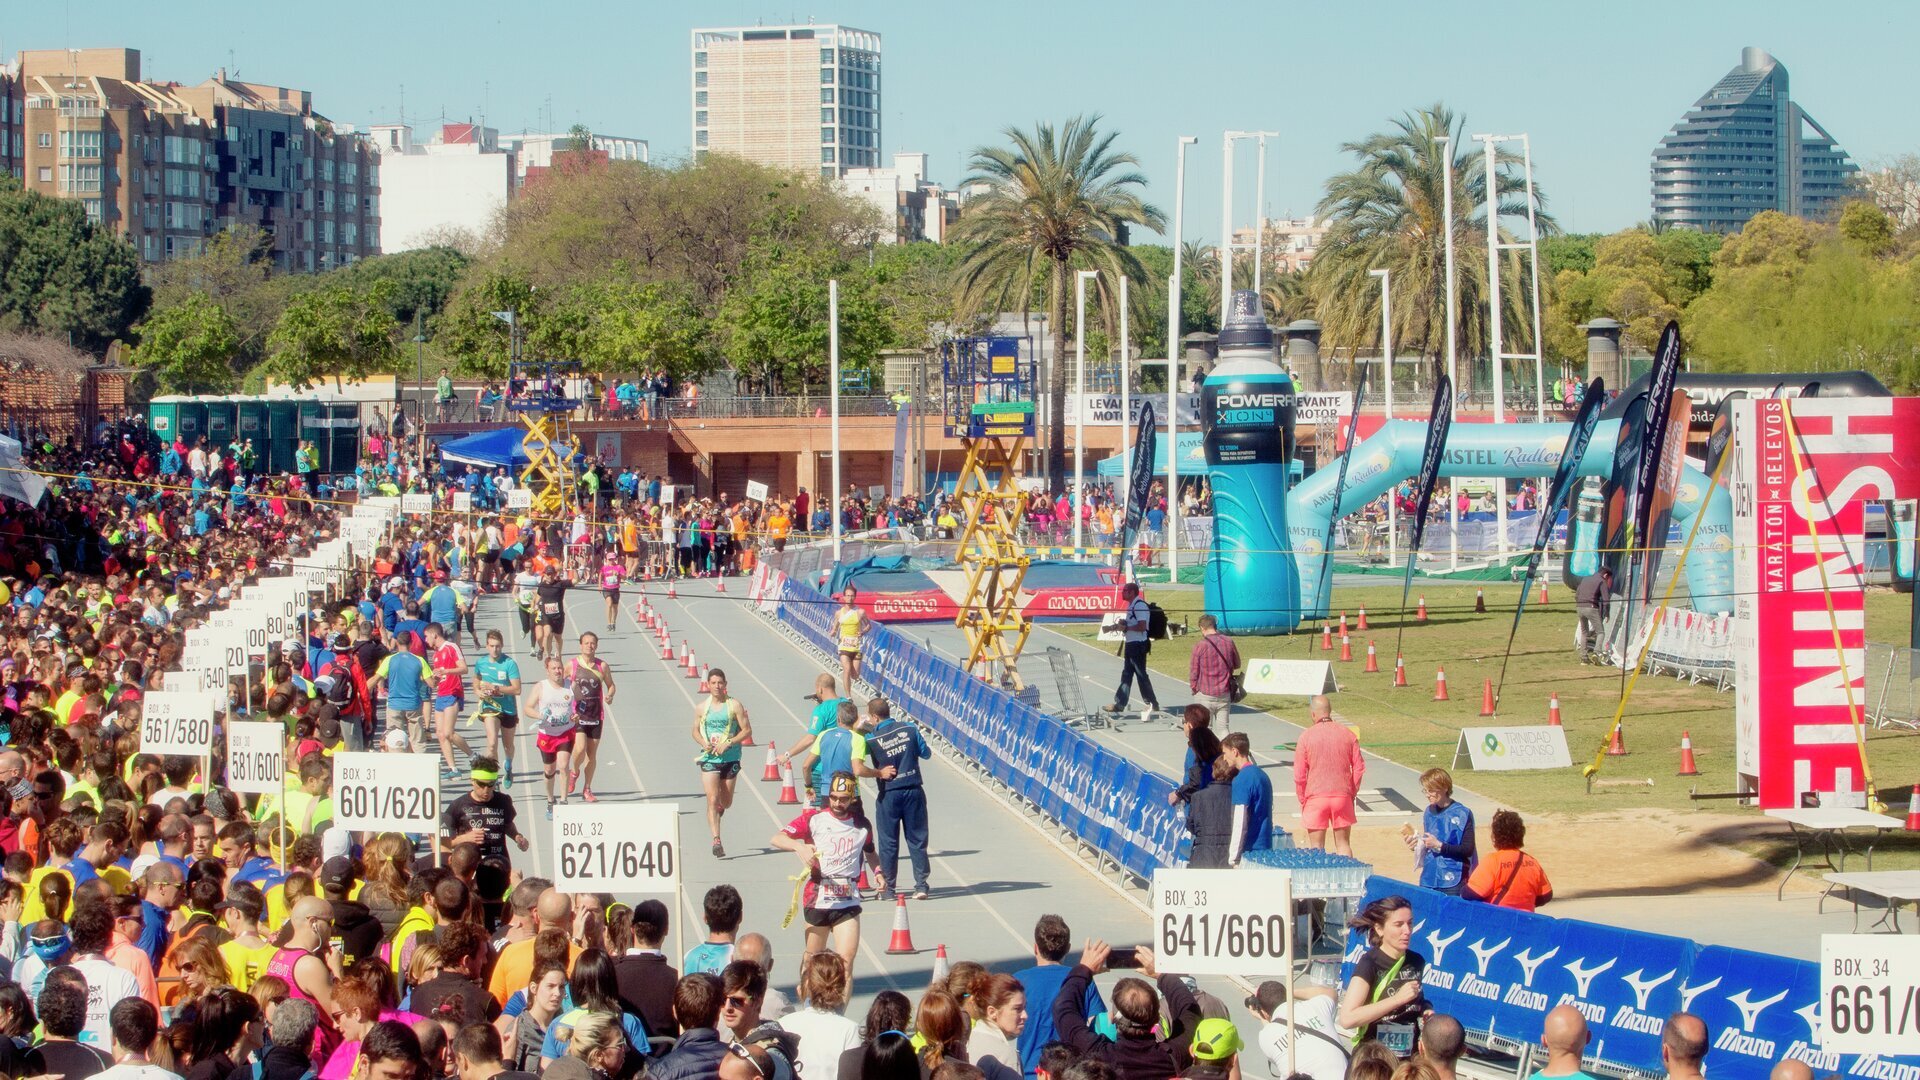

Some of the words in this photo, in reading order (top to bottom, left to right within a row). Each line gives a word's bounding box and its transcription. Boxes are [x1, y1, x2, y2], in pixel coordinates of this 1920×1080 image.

[1765, 402, 1782, 485] RELEVOS
[1764, 504, 1783, 593] MARATÓN
[874, 598, 938, 613] MONDO
[1048, 595, 1112, 609] MONDO
[145, 717, 210, 746] 561/580
[1503, 730, 1551, 744] TRINIDAD
[886, 744, 907, 758] STAFF
[1509, 744, 1555, 757] ALFONSO
[232, 751, 281, 783] 581/600
[340, 785, 436, 821] 601/620
[561, 841, 674, 879] 621/640
[1162, 912, 1286, 959] 641/660
[1834, 958, 1890, 979] BOX_34
